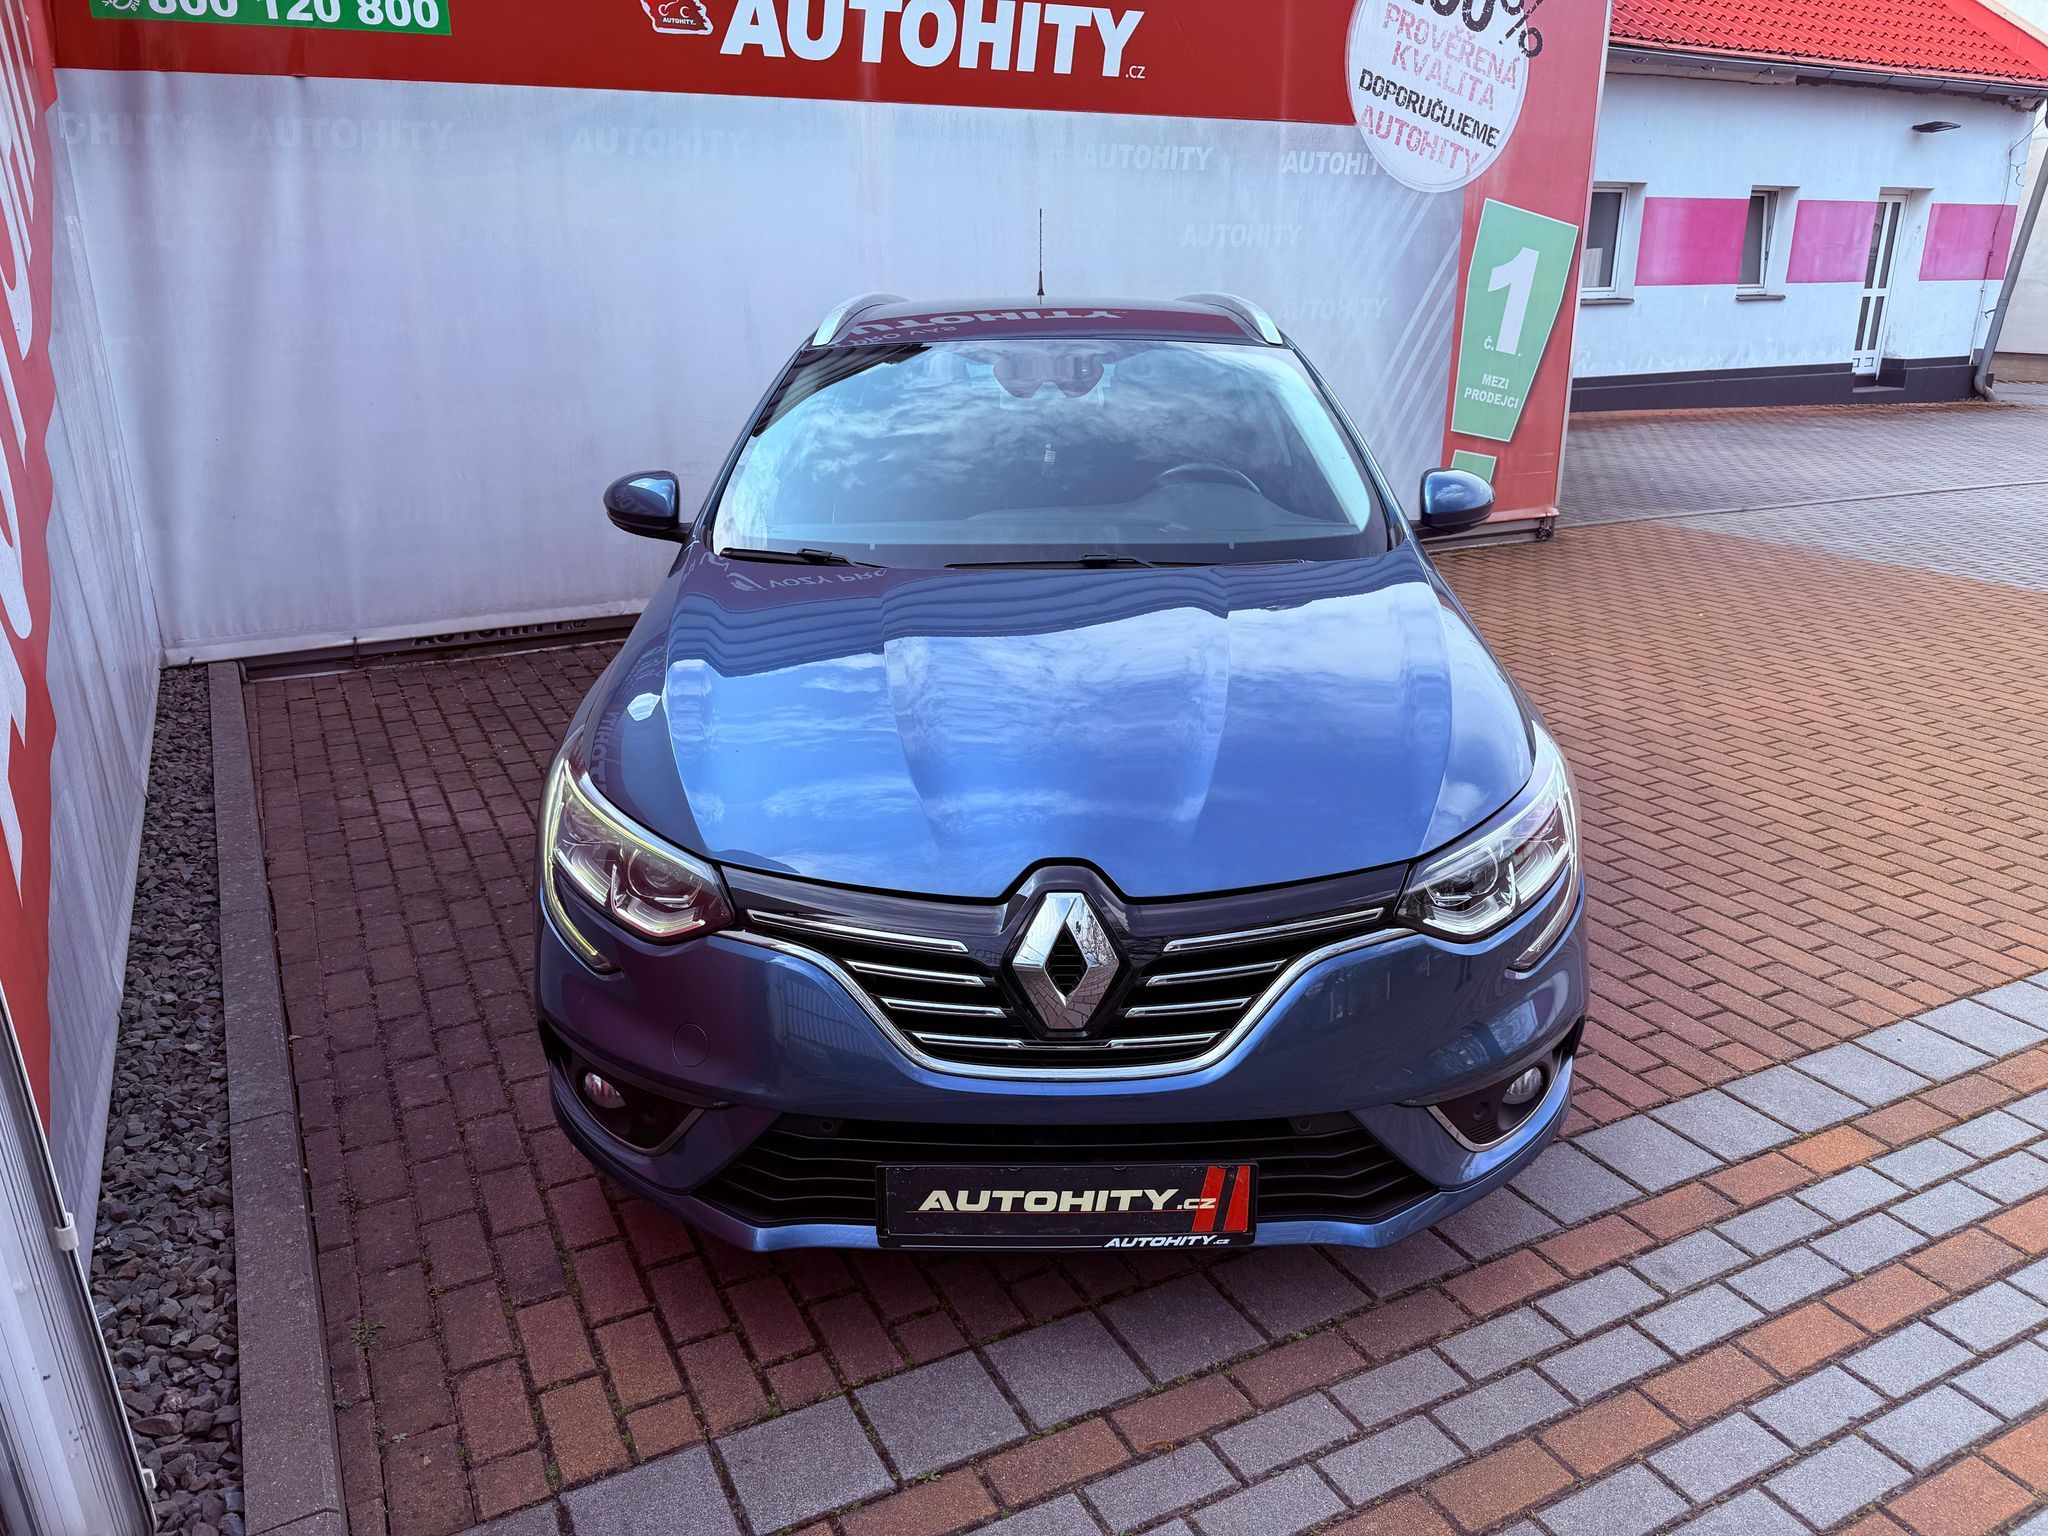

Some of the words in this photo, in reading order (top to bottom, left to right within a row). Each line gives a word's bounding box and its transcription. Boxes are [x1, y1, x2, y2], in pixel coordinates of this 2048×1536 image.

[357, 0, 439, 28] 800
[1382, 3, 1520, 90] PROVĚŘENÁ
[1391, 40, 1494, 111] KVALITA
[1358, 68, 1500, 149] DOPORUČUJEME
[1360, 105, 1481, 176] AUTOHITY
[1084, 142, 1213, 171] AUTOHITY
[1281, 150, 1391, 176] AUTOHIT
[1179, 223, 1304, 248] AUTOHITY
[1481, 373, 1509, 390] MEZI
[1464, 387, 1519, 409] PRODEJCI
